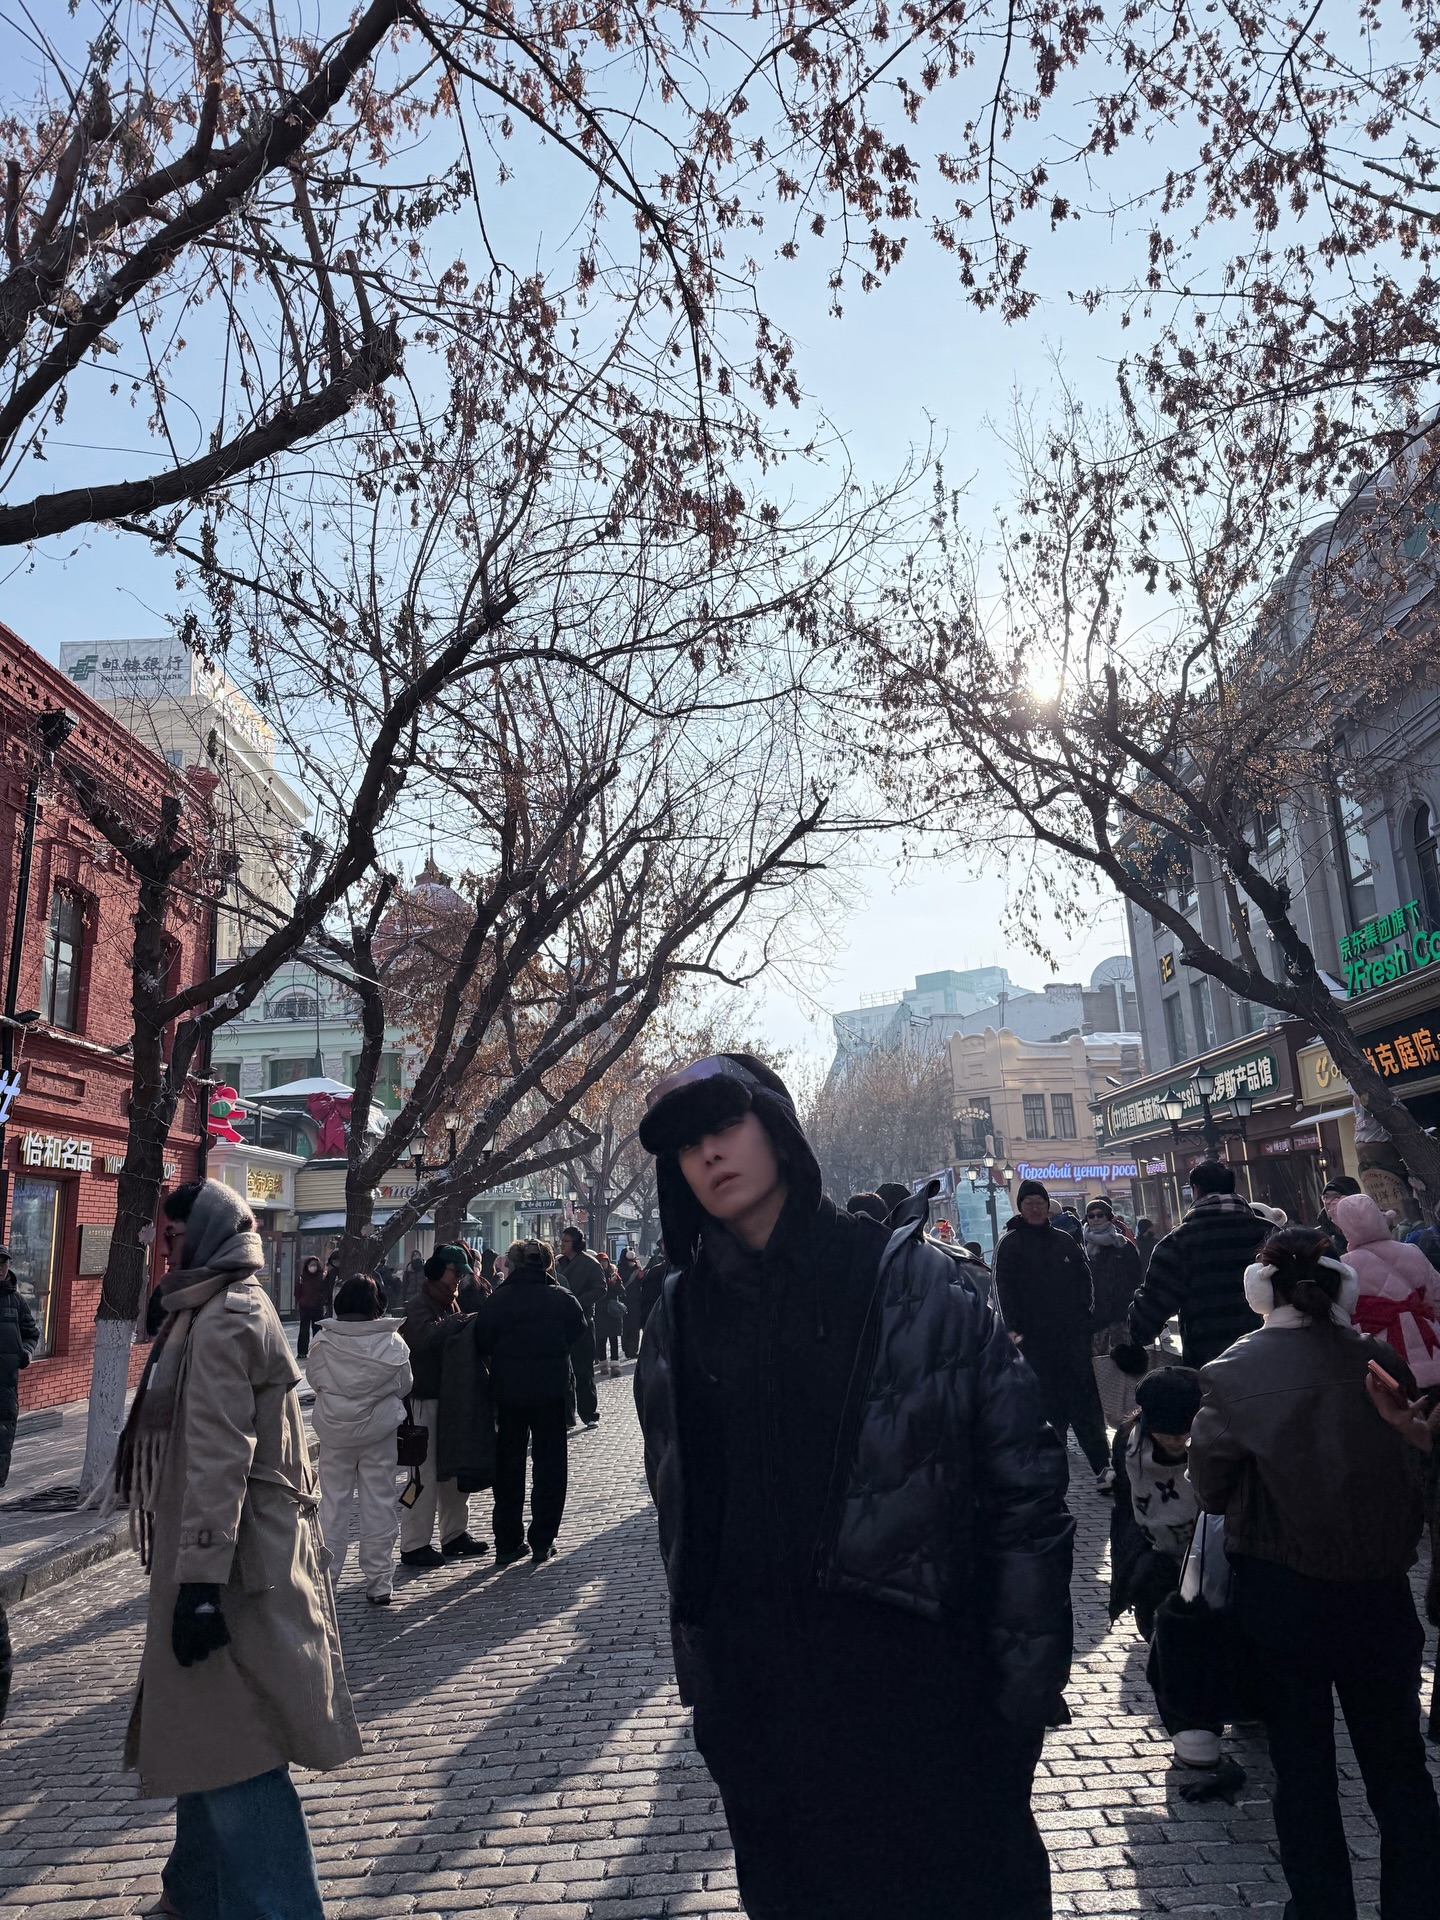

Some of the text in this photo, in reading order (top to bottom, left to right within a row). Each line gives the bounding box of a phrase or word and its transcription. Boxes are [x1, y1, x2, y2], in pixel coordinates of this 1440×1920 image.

[102, 656, 183, 676] 邮储银行
[1338, 899, 1419, 962] 京东集团旗下
[1343, 943, 1408, 999] 7Fresh
[22, 1130, 92, 1172] 怡和名品
[1018, 1162, 1071, 1180] Торговый
[1073, 1164, 1110, 1182] центр
